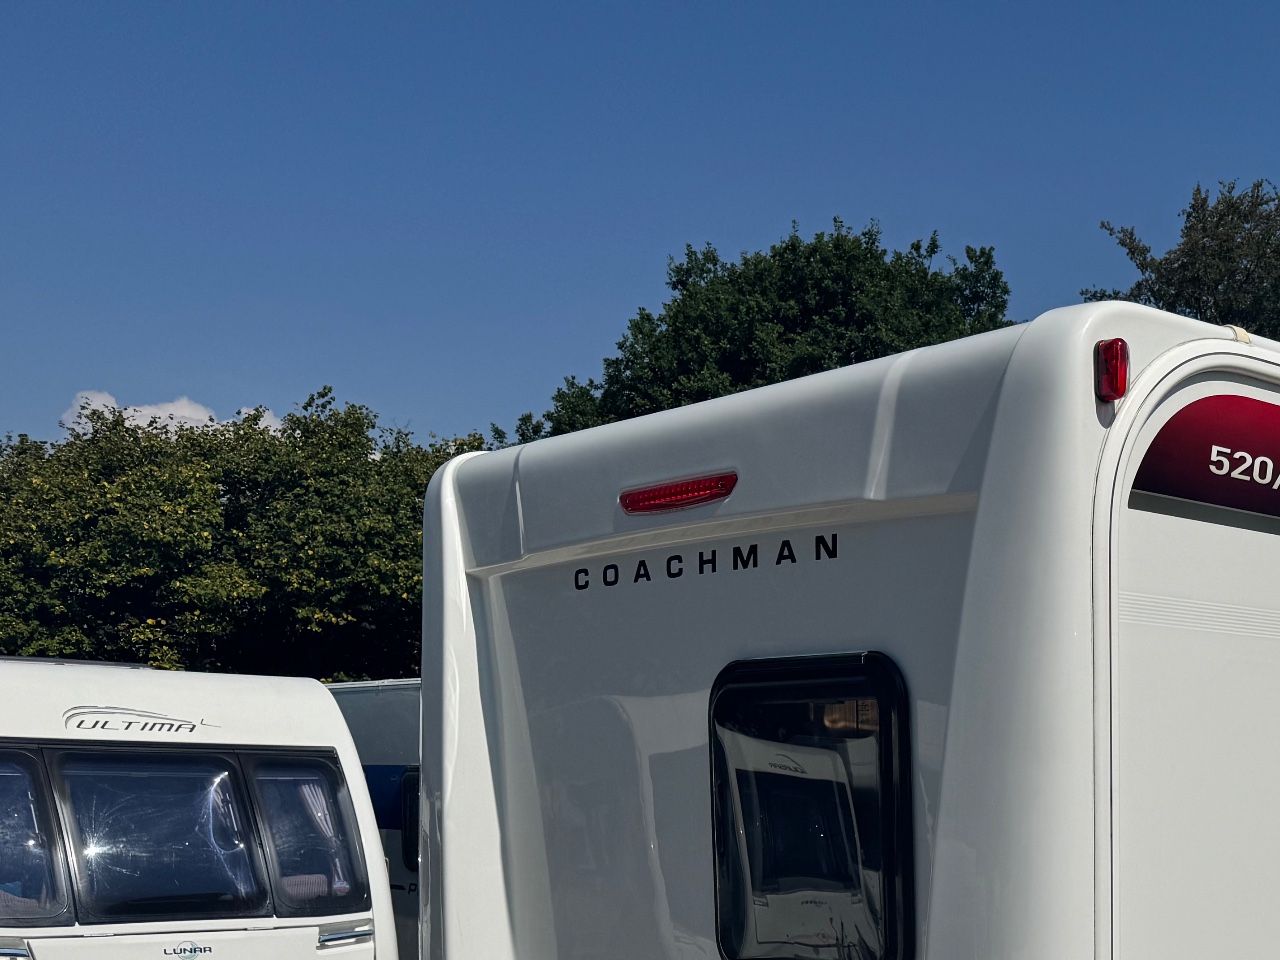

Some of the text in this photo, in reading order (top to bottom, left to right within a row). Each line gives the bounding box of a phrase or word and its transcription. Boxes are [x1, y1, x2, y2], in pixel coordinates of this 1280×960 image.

[573, 533, 838, 590] COACHMAN
[75, 719, 197, 733] ULTIMA
[163, 946, 212, 956] LUNAR
